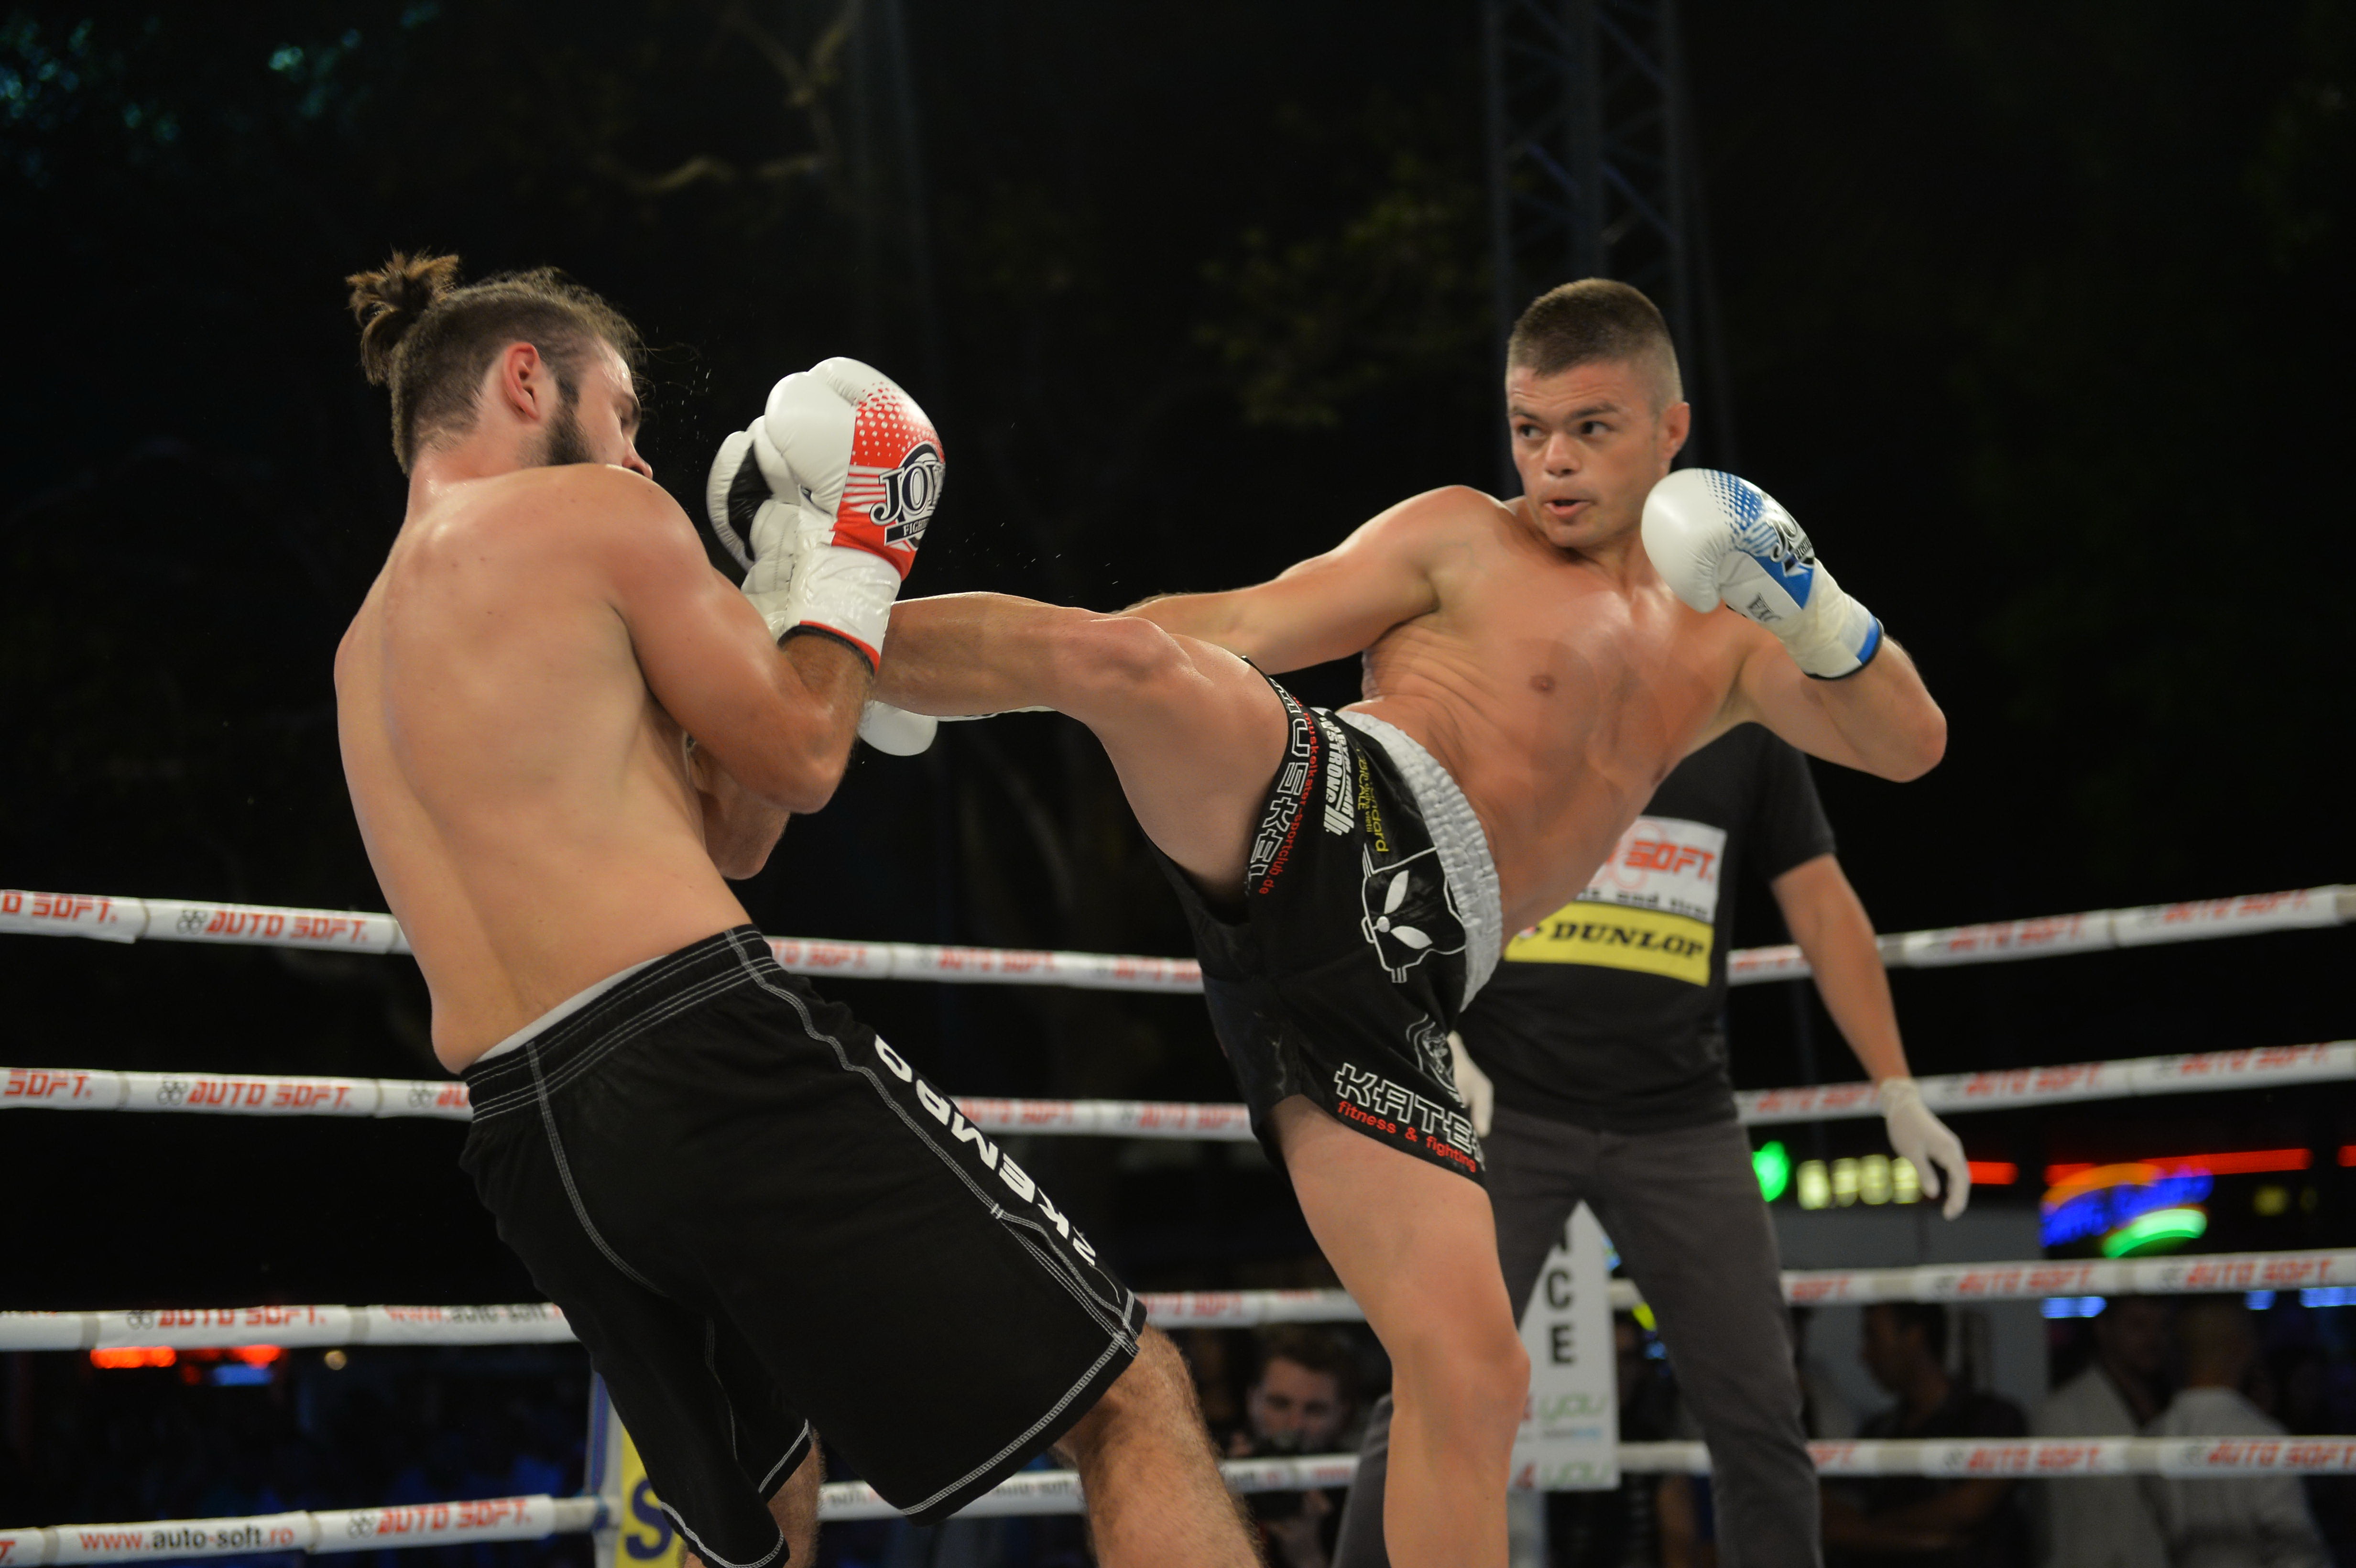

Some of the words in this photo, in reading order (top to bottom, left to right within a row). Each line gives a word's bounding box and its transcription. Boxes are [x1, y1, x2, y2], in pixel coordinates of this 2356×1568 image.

[206, 910, 285, 937] AUTO
[1550, 920, 1705, 959] DUNLOP
[188, 1079, 267, 1107] AUTO
[1338, 1101, 1396, 1134] fitness
[1405, 1126, 1418, 1142] &
[1426, 1135, 1476, 1173] fighting
[377, 1503, 450, 1535] AUTO
